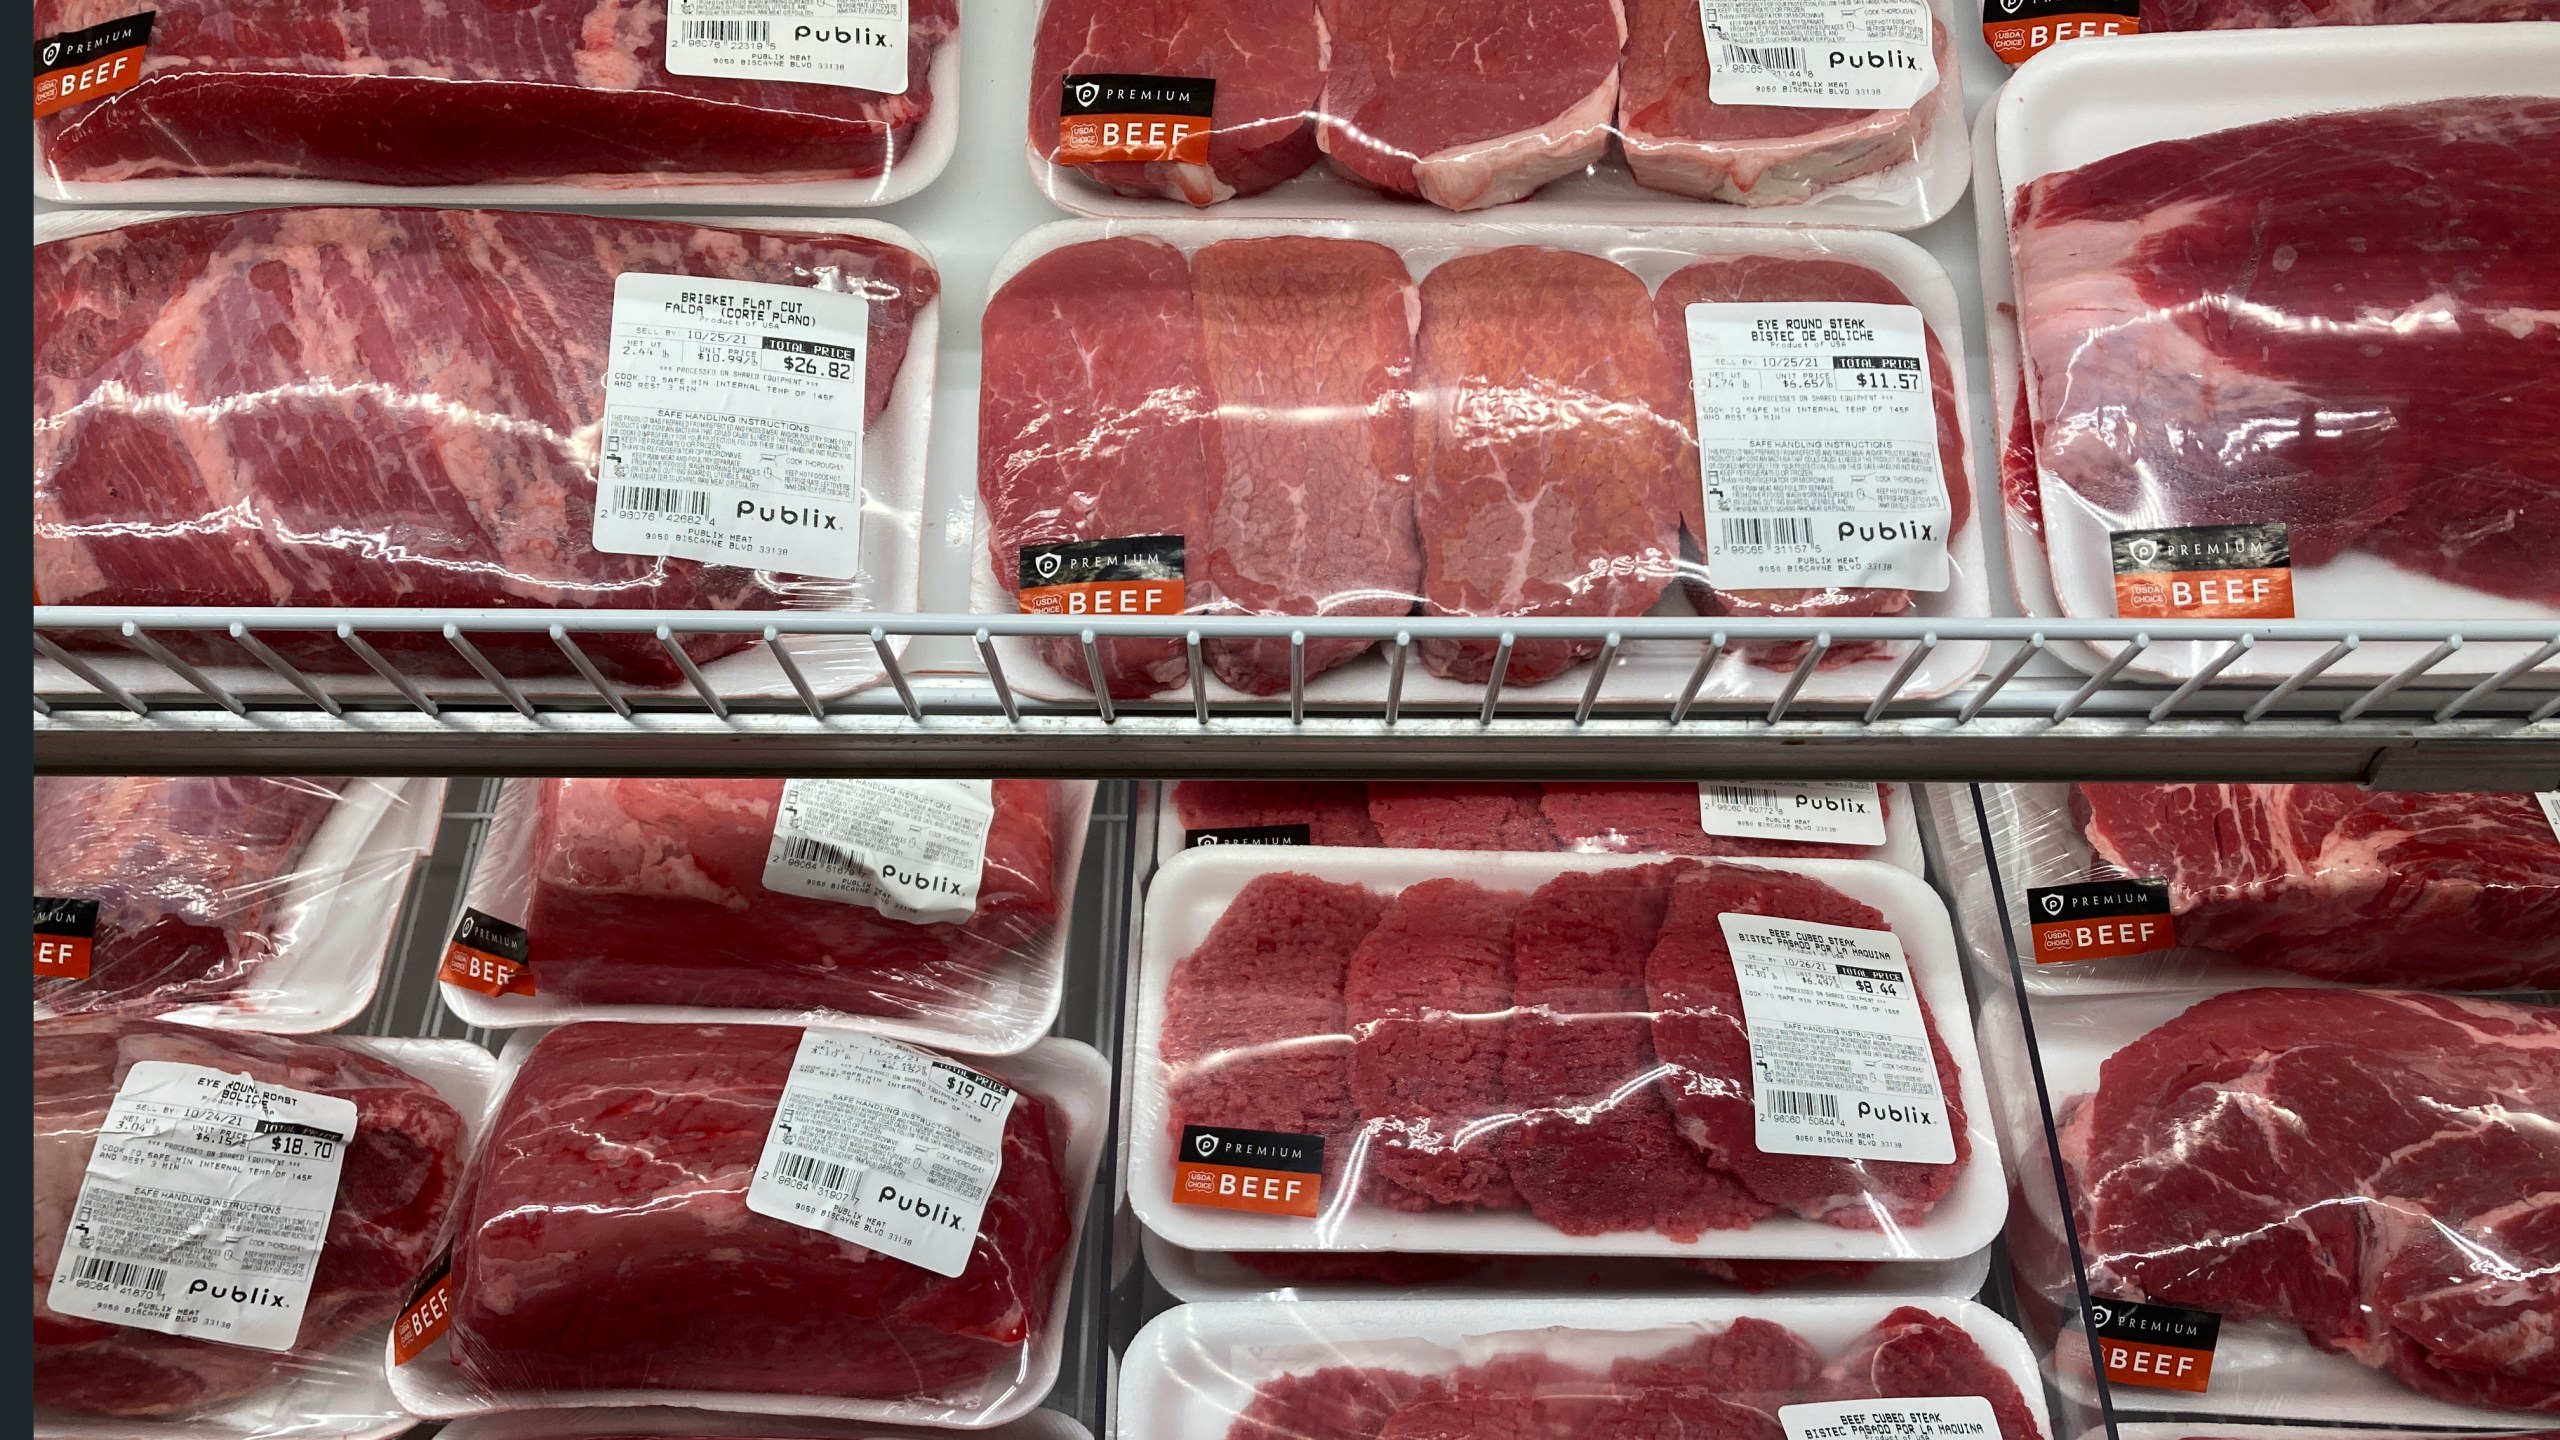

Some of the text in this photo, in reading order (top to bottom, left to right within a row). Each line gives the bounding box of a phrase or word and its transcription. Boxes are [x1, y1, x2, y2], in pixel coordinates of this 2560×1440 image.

[67, 28, 132, 54] PREMIUM
[795, 26, 887, 47] Publix
[1996, 39, 2022, 47] CHOICE
[2031, 22, 2119, 47] BEEF
[688, 40, 763, 50] 96076 22319
[741, 59, 784, 67] BISCAYNE
[1829, 51, 1918, 70] Publix
[61, 56, 128, 96] BEEF
[1106, 89, 1190, 101] PREMIUM
[1103, 123, 1190, 146] BEEF
[682, 292, 803, 313] BRISKET FLAT CUT
[665, 303, 816, 326] FALDA (CORTE PLANO)
[1757, 319, 1866, 330] EYE ROUND STEAK
[688, 330, 747, 344] 10/25/21
[1751, 330, 1874, 341] BISTEC DE BOLICHE
[700, 346, 757, 357] UNIT PRICE
[770, 339, 851, 359] TOTAL PRICE
[783, 356, 850, 380] $26.82
[1762, 358, 1819, 368] 10/25/21
[1840, 358, 1917, 369] TOTAL PRICE
[1856, 373, 1918, 390] $11.57
[657, 409, 810, 432] SAFE HANDLING INSTRUCTIONS
[1750, 440, 1893, 449] SAFE HANDLING INSTRUCTIONS
[619, 511, 701, 526] 96076 42682
[736, 500, 837, 530] Publix
[688, 528, 753, 543] PUBLIX MEAT
[1838, 520, 1933, 542] Publix
[675, 534, 723, 548] BISCAYNE
[729, 542, 753, 551] BLVD
[759, 546, 788, 556] 33138
[2168, 542, 2263, 556] PREMIUM
[1071, 554, 1159, 569] PREMIUM
[1787, 564, 1832, 572] BISCAYNE
[1838, 563, 1862, 571] BLVD
[1868, 563, 1892, 571] 33138
[2133, 594, 2163, 603] CHOICE
[2135, 586, 2160, 594] USDA
[2172, 578, 2269, 606] BEEF
[1034, 605, 1060, 614] CHOICE
[1036, 598, 1058, 606] USDA
[1069, 589, 1162, 615] BEEF
[1796, 794, 1865, 813] Publix
[882, 864, 962, 895] Publix
[2072, 893, 2148, 908] PREMIUM
[475, 927, 518, 949] PREMIUM
[1769, 929, 1856, 947] BEEF CUBED STEAK
[2046, 939, 2070, 947] CHOICE
[2076, 922, 2155, 947] BEEF
[1739, 934, 1891, 960] BISTEC PASADO POR LA MAQUINA
[469, 956, 509, 985] BEE
[1784, 959, 1827, 971] 10/26/21
[1841, 967, 1901, 982] TOTAL PRICE
[1856, 980, 1897, 996] $8.44
[1783, 1022, 1892, 1041] SAFE HANDLING INSTRUCTIONS
[868, 1048, 920, 1062] 10/26/21
[198, 1077, 221, 1089] EYE
[975, 1074, 1009, 1095] PRICE
[221, 1089, 269, 1109] BOLICE
[946, 1076, 1001, 1112] $19.07
[832, 1094, 854, 1104] SAFE
[856, 1098, 900, 1116] HANDLING
[1858, 1101, 1931, 1124] Publix
[184, 1109, 242, 1126] 10/24/21
[272, 1136, 333, 1159] $18.70
[1226, 1142, 1302, 1159] PREMIUM
[817, 1187, 849, 1201] 31907
[1188, 1180, 1212, 1189] CHOICE
[1219, 1173, 1301, 1201] BEEF
[134, 1187, 281, 1215] SAFE HANDLING INSTRUCTIONS
[878, 1186, 963, 1230] Publix
[833, 1204, 887, 1228] PUBLIX MEAT
[864, 1223, 884, 1236] BLVD
[888, 1232, 912, 1246] 33138
[189, 1279, 285, 1308] Publix
[412, 1288, 448, 1336] BEEF
[2118, 1316, 2197, 1335] PREMIUM
[2110, 1348, 2194, 1376] BEEF
[1840, 1413, 1942, 1425] BEEF CUBED STEAK
[1805, 1424, 1984, 1439] BISTEC PASADO POR LA MAQUINA
